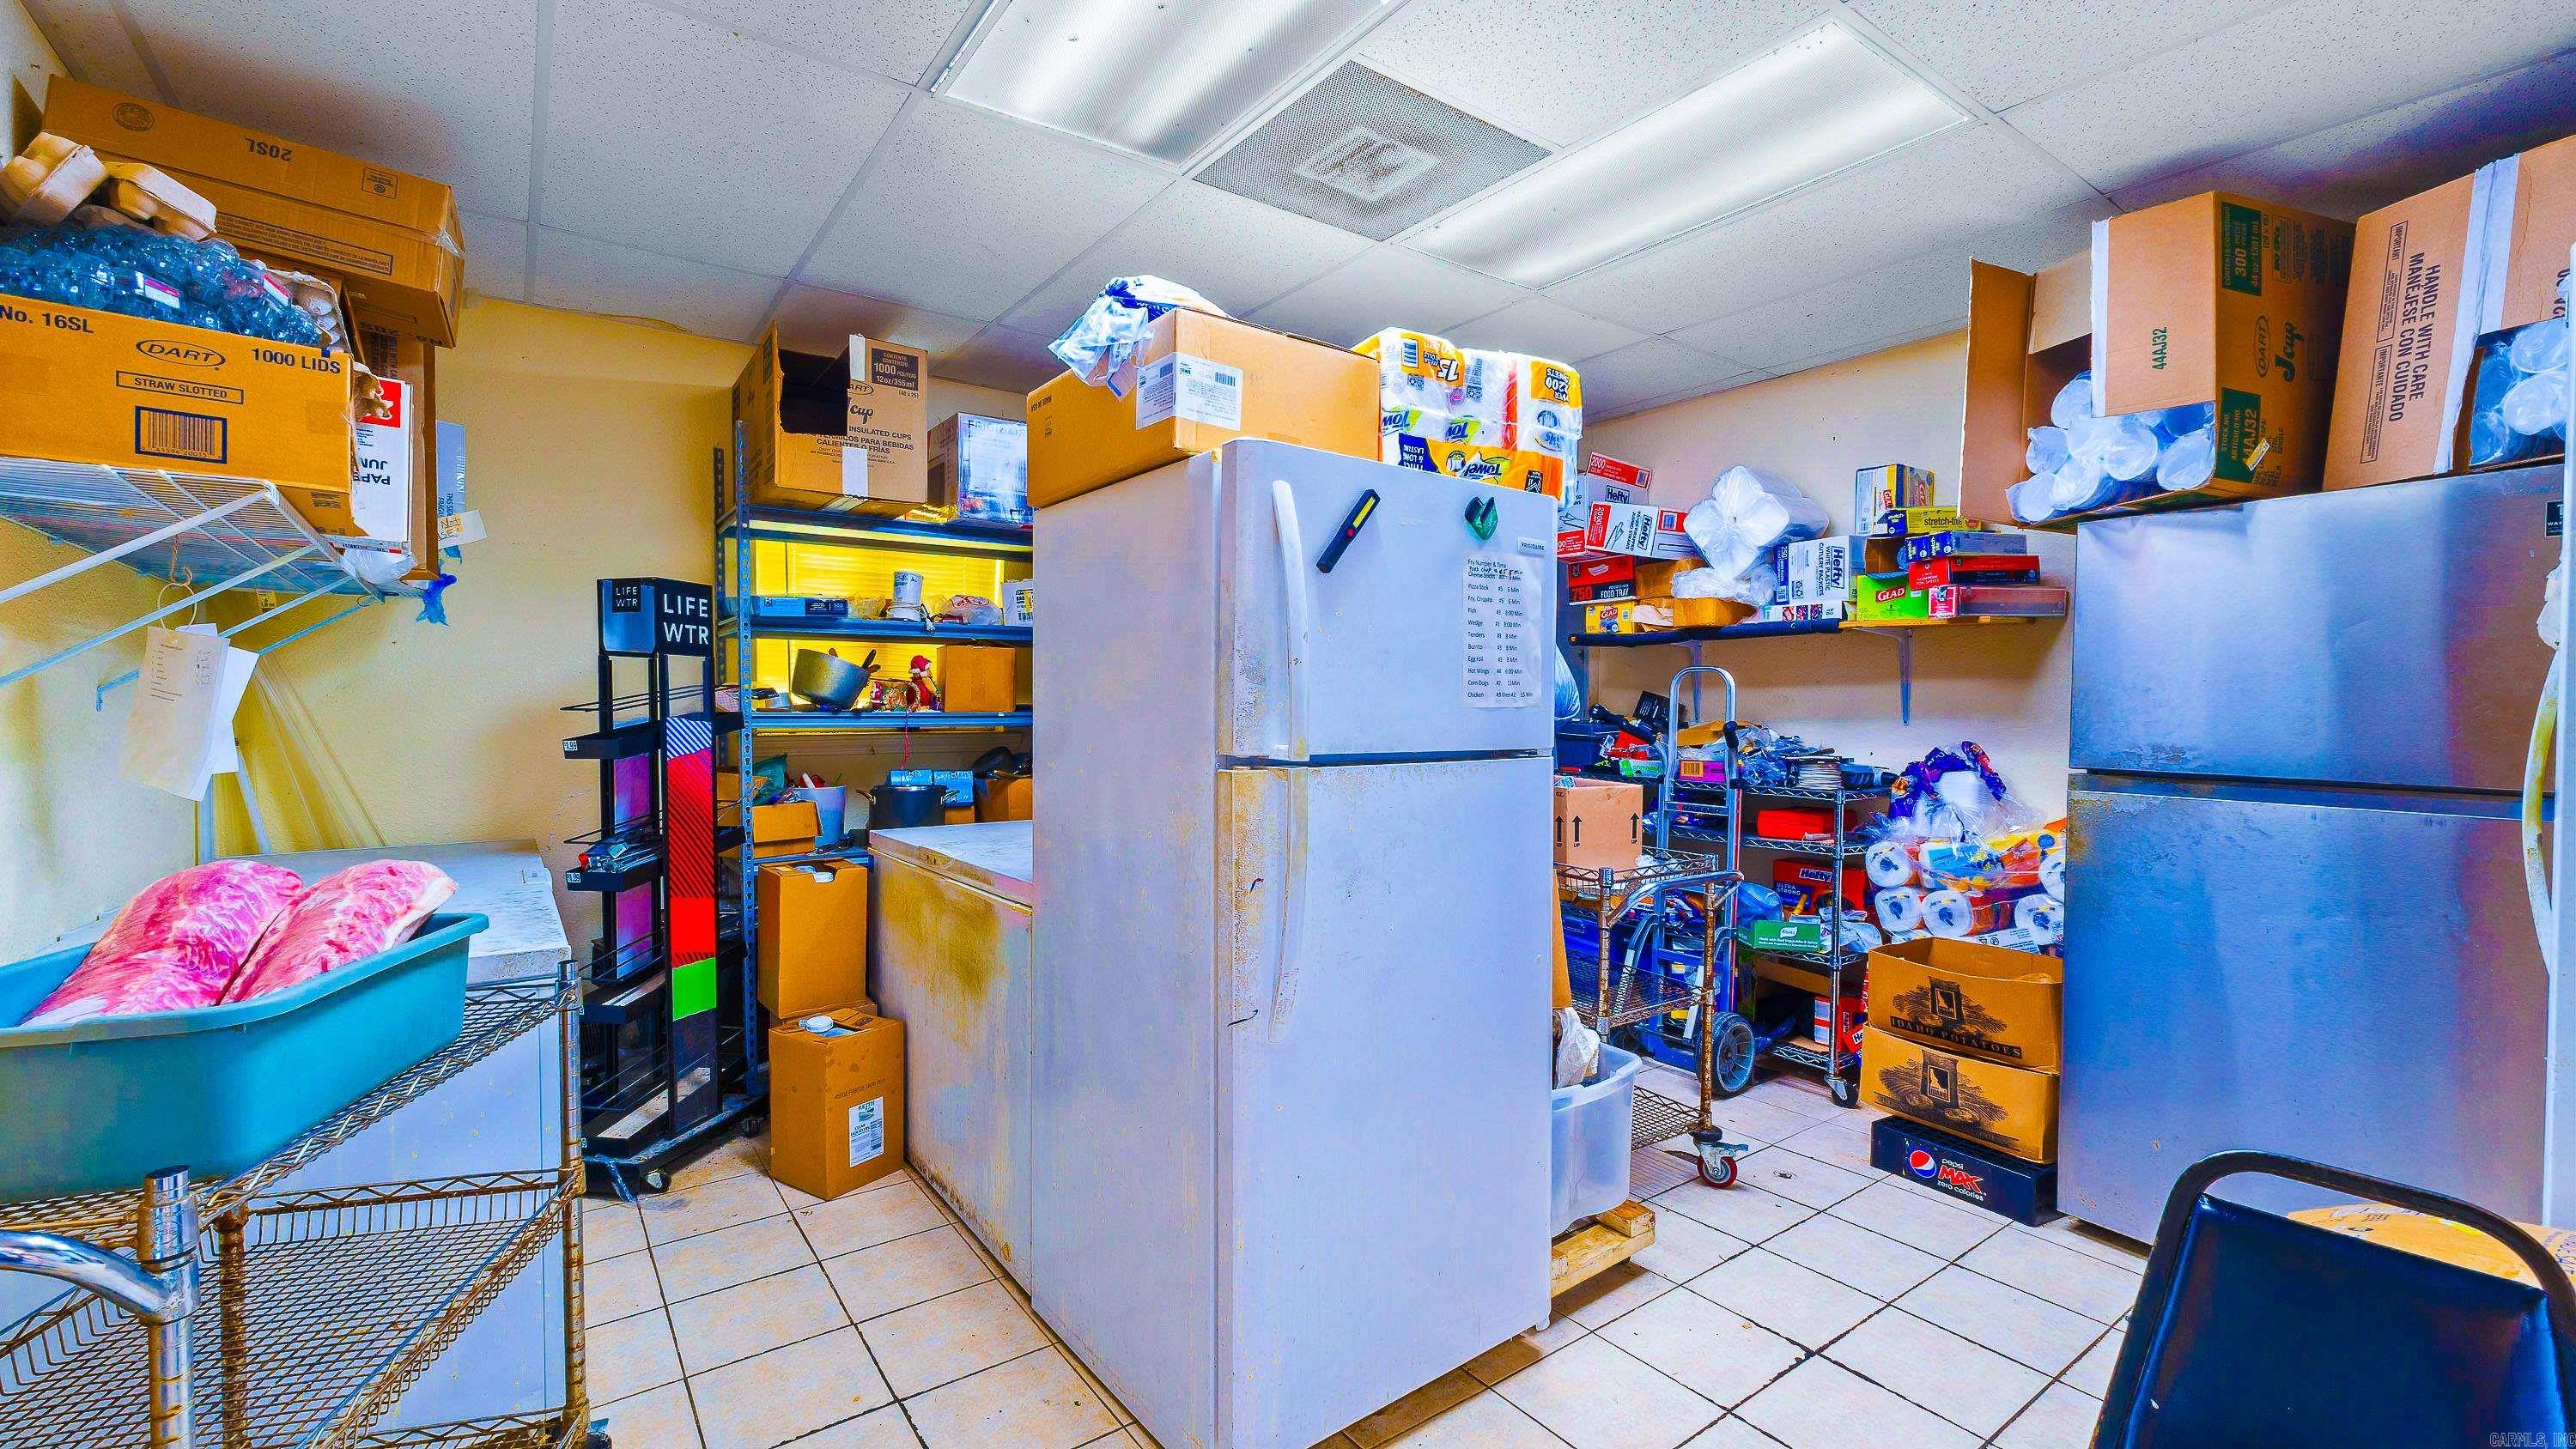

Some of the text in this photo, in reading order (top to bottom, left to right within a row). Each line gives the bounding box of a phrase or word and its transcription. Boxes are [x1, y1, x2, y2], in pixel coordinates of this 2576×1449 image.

[245, 137, 292, 161] 20SL
[2391, 226, 2403, 260] IMPORTANT
[2235, 247, 2246, 277] 300
[0, 305, 94, 334] No. 16SL
[2397, 328, 2415, 359] CON
[2409, 264, 2440, 402] HANDLE WITH CARE
[147, 343, 216, 363] DART
[2152, 326, 2167, 371] 44AJ32
[2259, 324, 2268, 370] DART
[2275, 321, 2305, 382] Jcup
[252, 348, 341, 373] 1000 LIDS
[874, 362, 896, 374] 1000
[1437, 359, 1459, 381] 15
[2375, 349, 2390, 387] IMPORTANTE
[134, 378, 227, 398] STRAW SLOTTED
[2389, 360, 2411, 422] CUIDADO
[848, 425, 912, 440] INSULATED CUPS
[860, 437, 914, 451] PARA BEBIDAS
[1591, 456, 1605, 469] 2000
[1607, 488, 1627, 501] Hefty
[1595, 507, 1604, 525] 2000
[1639, 518, 1651, 548] Hefty
[1831, 549, 1844, 586] Hefty
[616, 587, 638, 596] LIFE
[616, 598, 638, 607] WTR
[1571, 586, 1593, 602] 750
[1601, 587, 1629, 599] FOOD TRAY
[1877, 588, 1905, 602] GLAD
[664, 593, 708, 618] LIFE
[1601, 609, 1618, 618] GLAD
[663, 621, 709, 645] WTR
[1801, 870, 1832, 881] Hefty
[1892, 1016, 2021, 1058] IDAHO POTATOES
[1942, 1158, 1964, 1169] pepsi
[1937, 1180, 1984, 1201] zero calories
[1938, 1165, 1983, 1195] MAX
